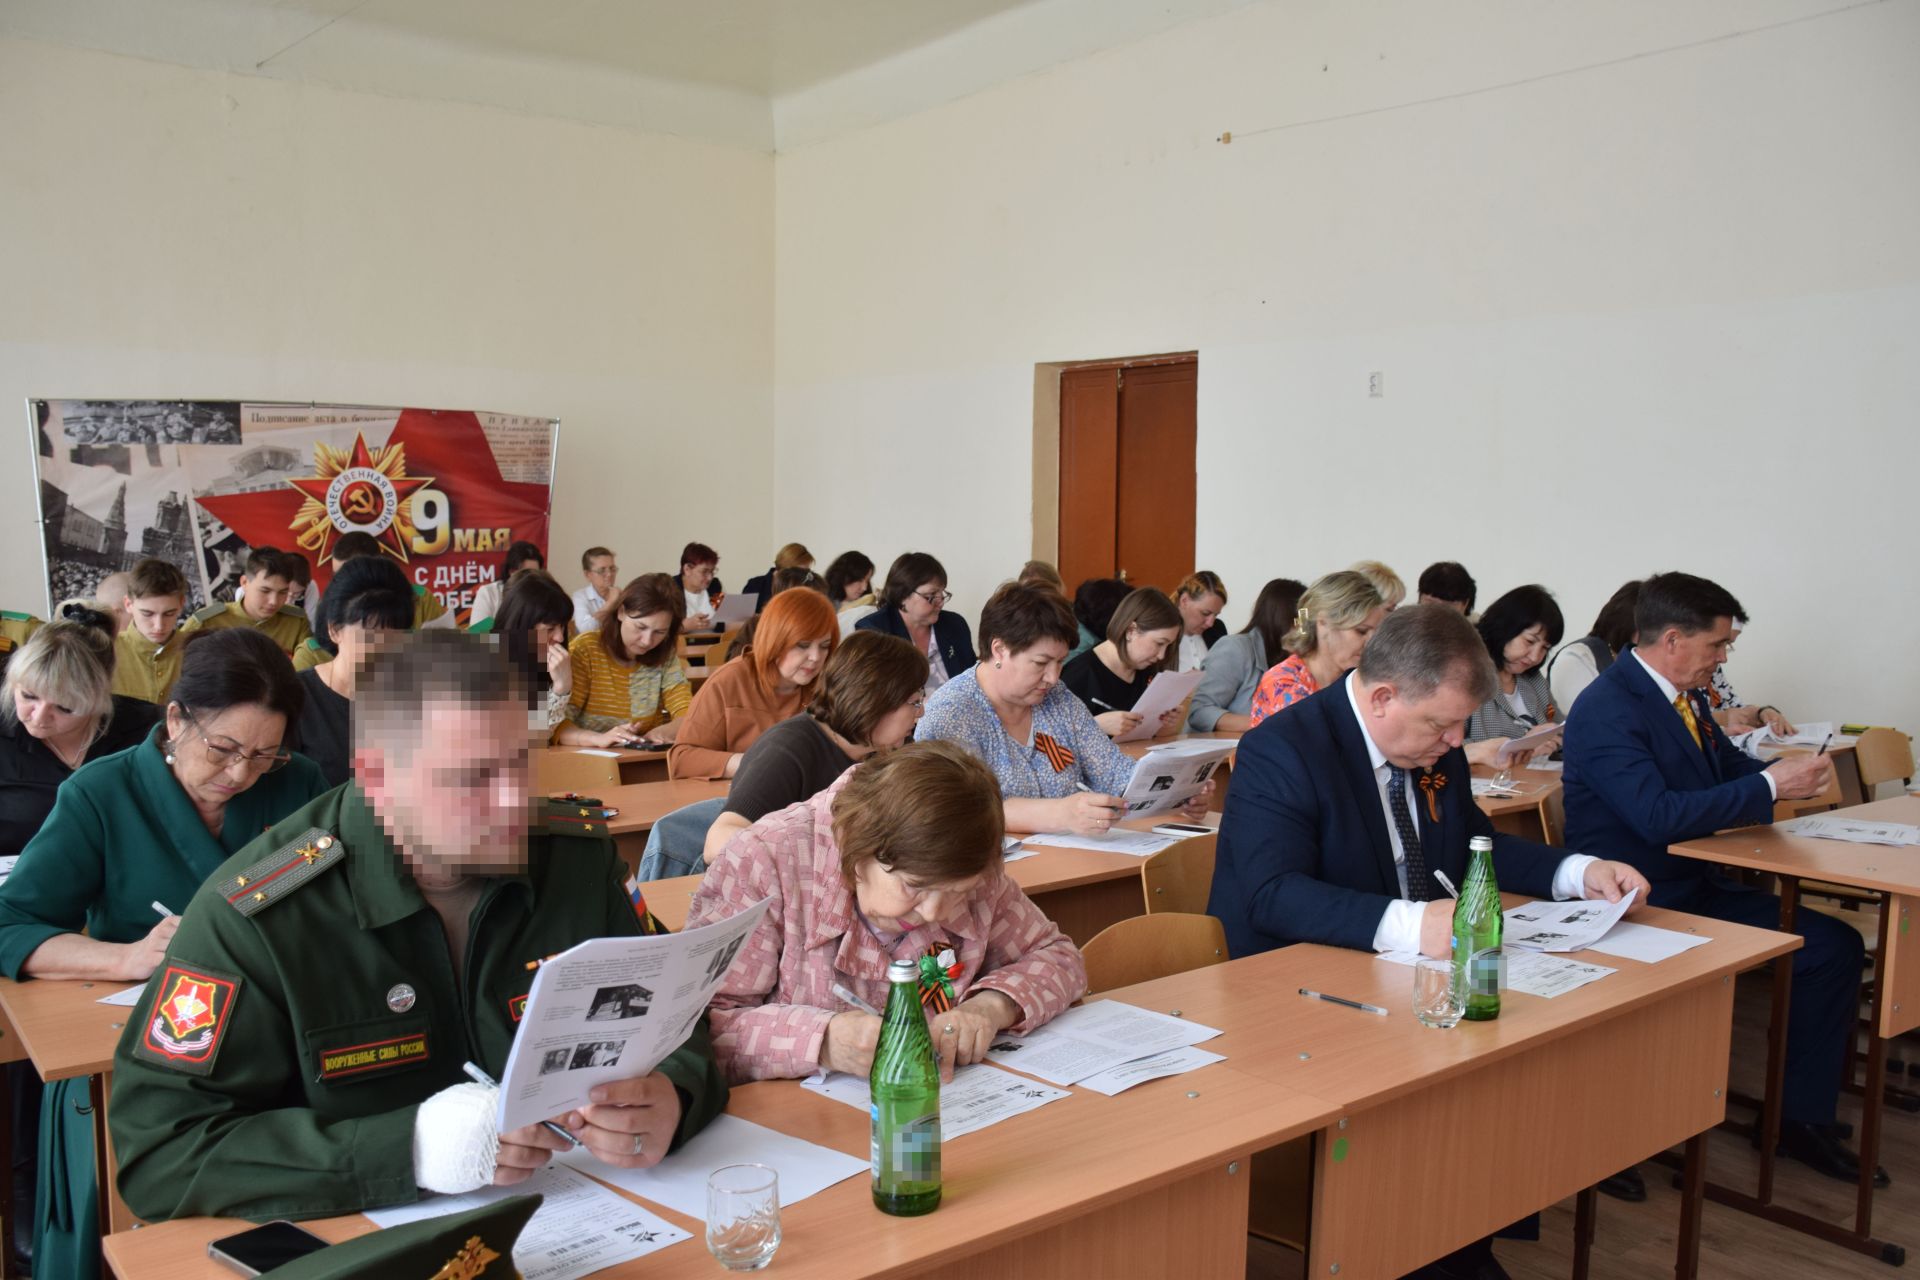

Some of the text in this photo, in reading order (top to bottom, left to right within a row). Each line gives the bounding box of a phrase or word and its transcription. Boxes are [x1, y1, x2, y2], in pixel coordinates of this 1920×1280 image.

[314, 415, 336, 424] акта
[329, 470, 388, 529] ОТЕЧЕСТВЕННАЯ
[411, 489, 511, 555] 9 МАЯ
[415, 560, 496, 588] С ДНЁМ
[433, 590, 473, 610] ОБЕ
[325, 1040, 425, 1071] ВООРУЖЕННЫЕ СИЛЫ РОССИИ
